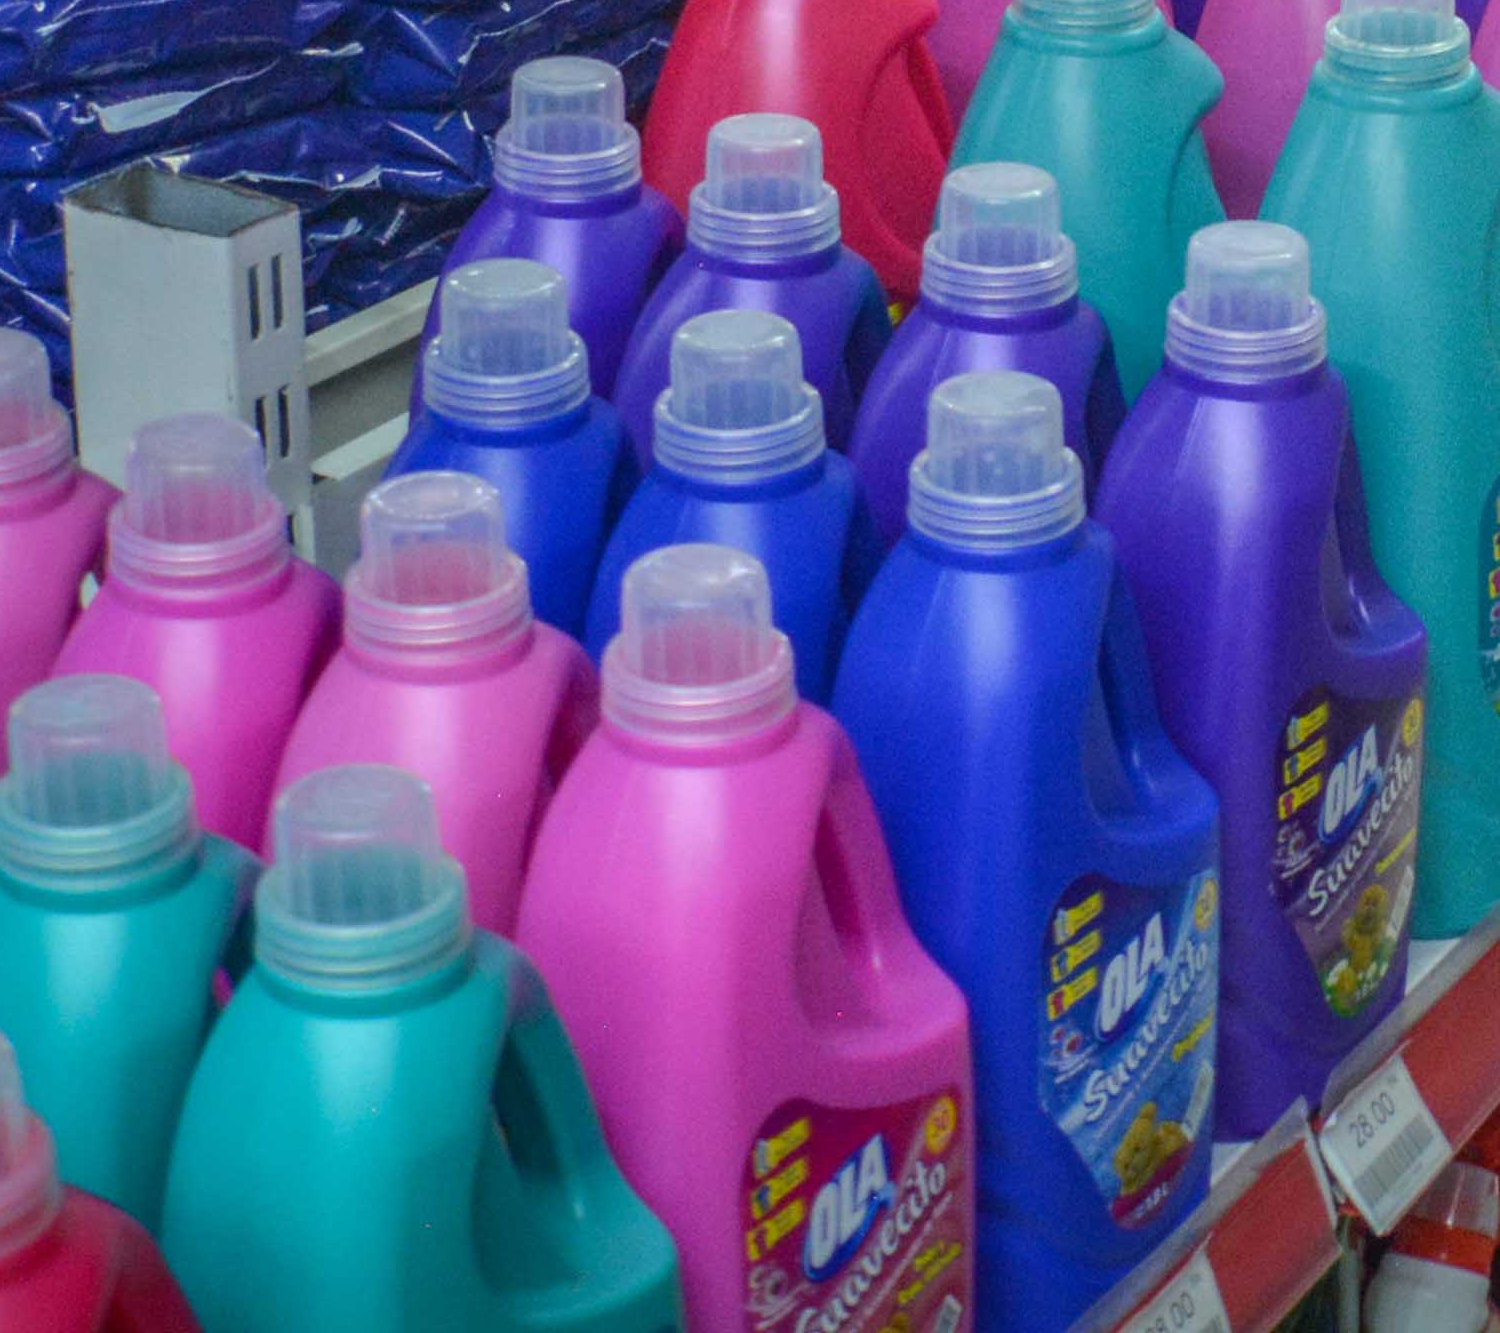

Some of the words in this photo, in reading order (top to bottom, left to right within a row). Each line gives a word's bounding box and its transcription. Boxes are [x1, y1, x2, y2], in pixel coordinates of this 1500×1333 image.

[1324, 723, 1379, 835] OLA
[1083, 939, 1208, 1123] Suavecito
[1100, 911, 1165, 1035] OLA
[1350, 1091, 1396, 1149] 28.00
[808, 1132, 889, 1271] OLA
